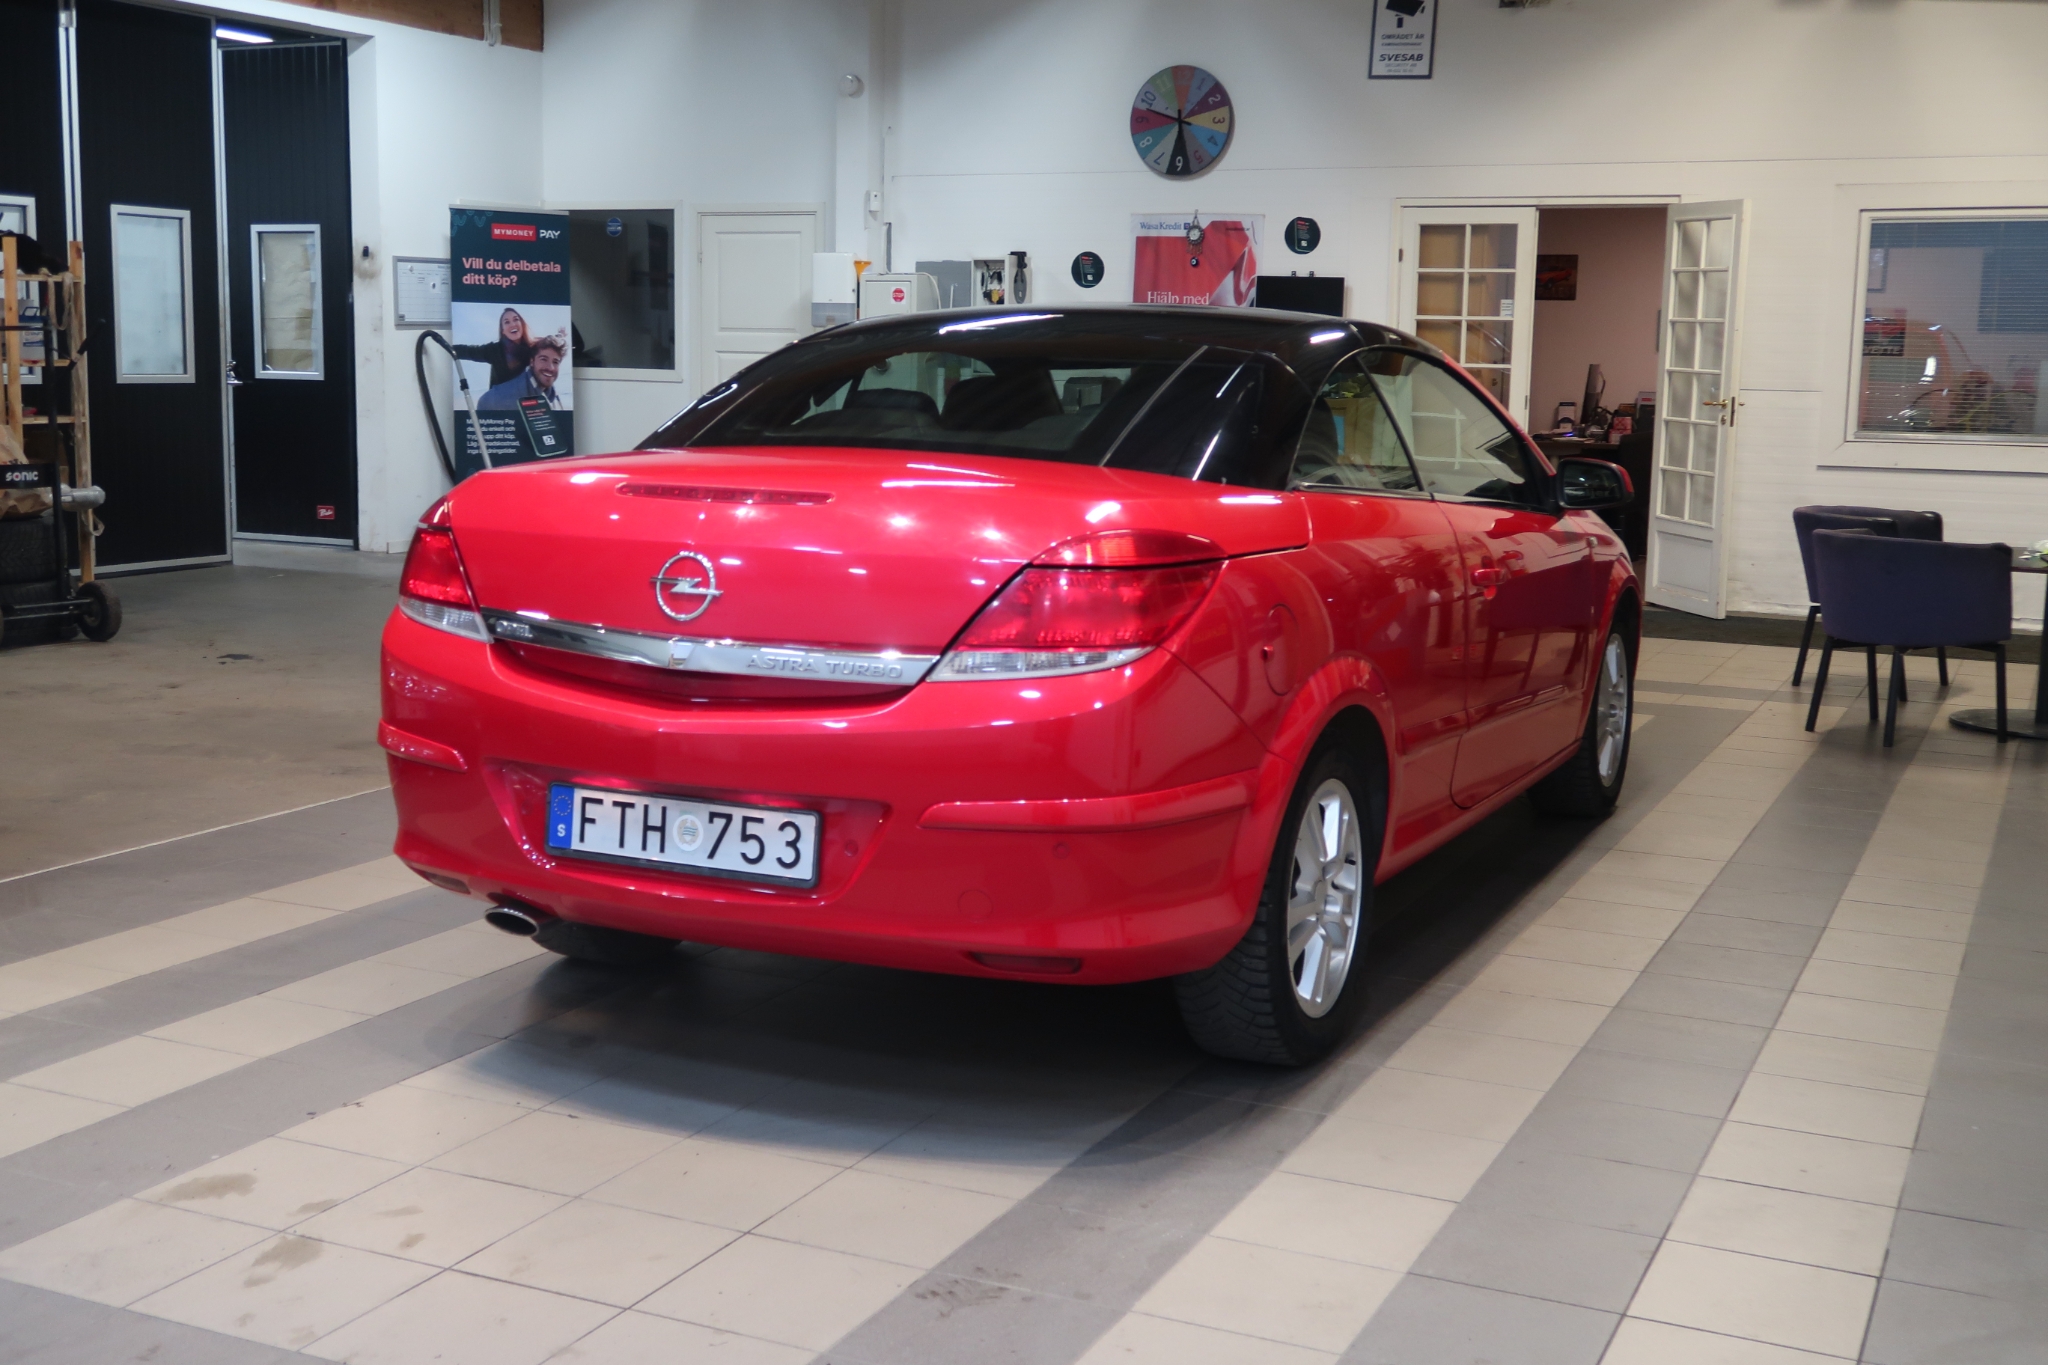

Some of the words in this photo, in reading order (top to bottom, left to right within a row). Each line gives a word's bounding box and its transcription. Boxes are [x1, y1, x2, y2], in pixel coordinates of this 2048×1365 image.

[1379, 53, 1424, 62] SVESAB
[1141, 90, 1157, 109] 10
[1208, 93, 1222, 105] 2
[1135, 115, 1150, 124] 9
[1212, 116, 1226, 125] 3
[1139, 136, 1153, 148] 8
[1207, 135, 1219, 147] 4
[1153, 152, 1166, 166] 7
[1193, 150, 1204, 165] 5
[493, 229, 534, 237] MYMONEY
[539, 230, 561, 239] PAY
[462, 257, 483, 270] Vill
[485, 259, 502, 270] du
[504, 260, 562, 273] delbetala
[462, 273, 485, 285] ditt
[488, 274, 518, 288] köp?
[1183, 292, 1210, 304] med
[748, 654, 819, 674] ASTRA
[826, 659, 903, 679] TURBO
[556, 824, 566, 837] S
[579, 796, 667, 854] FTH
[706, 811, 802, 869] 753
